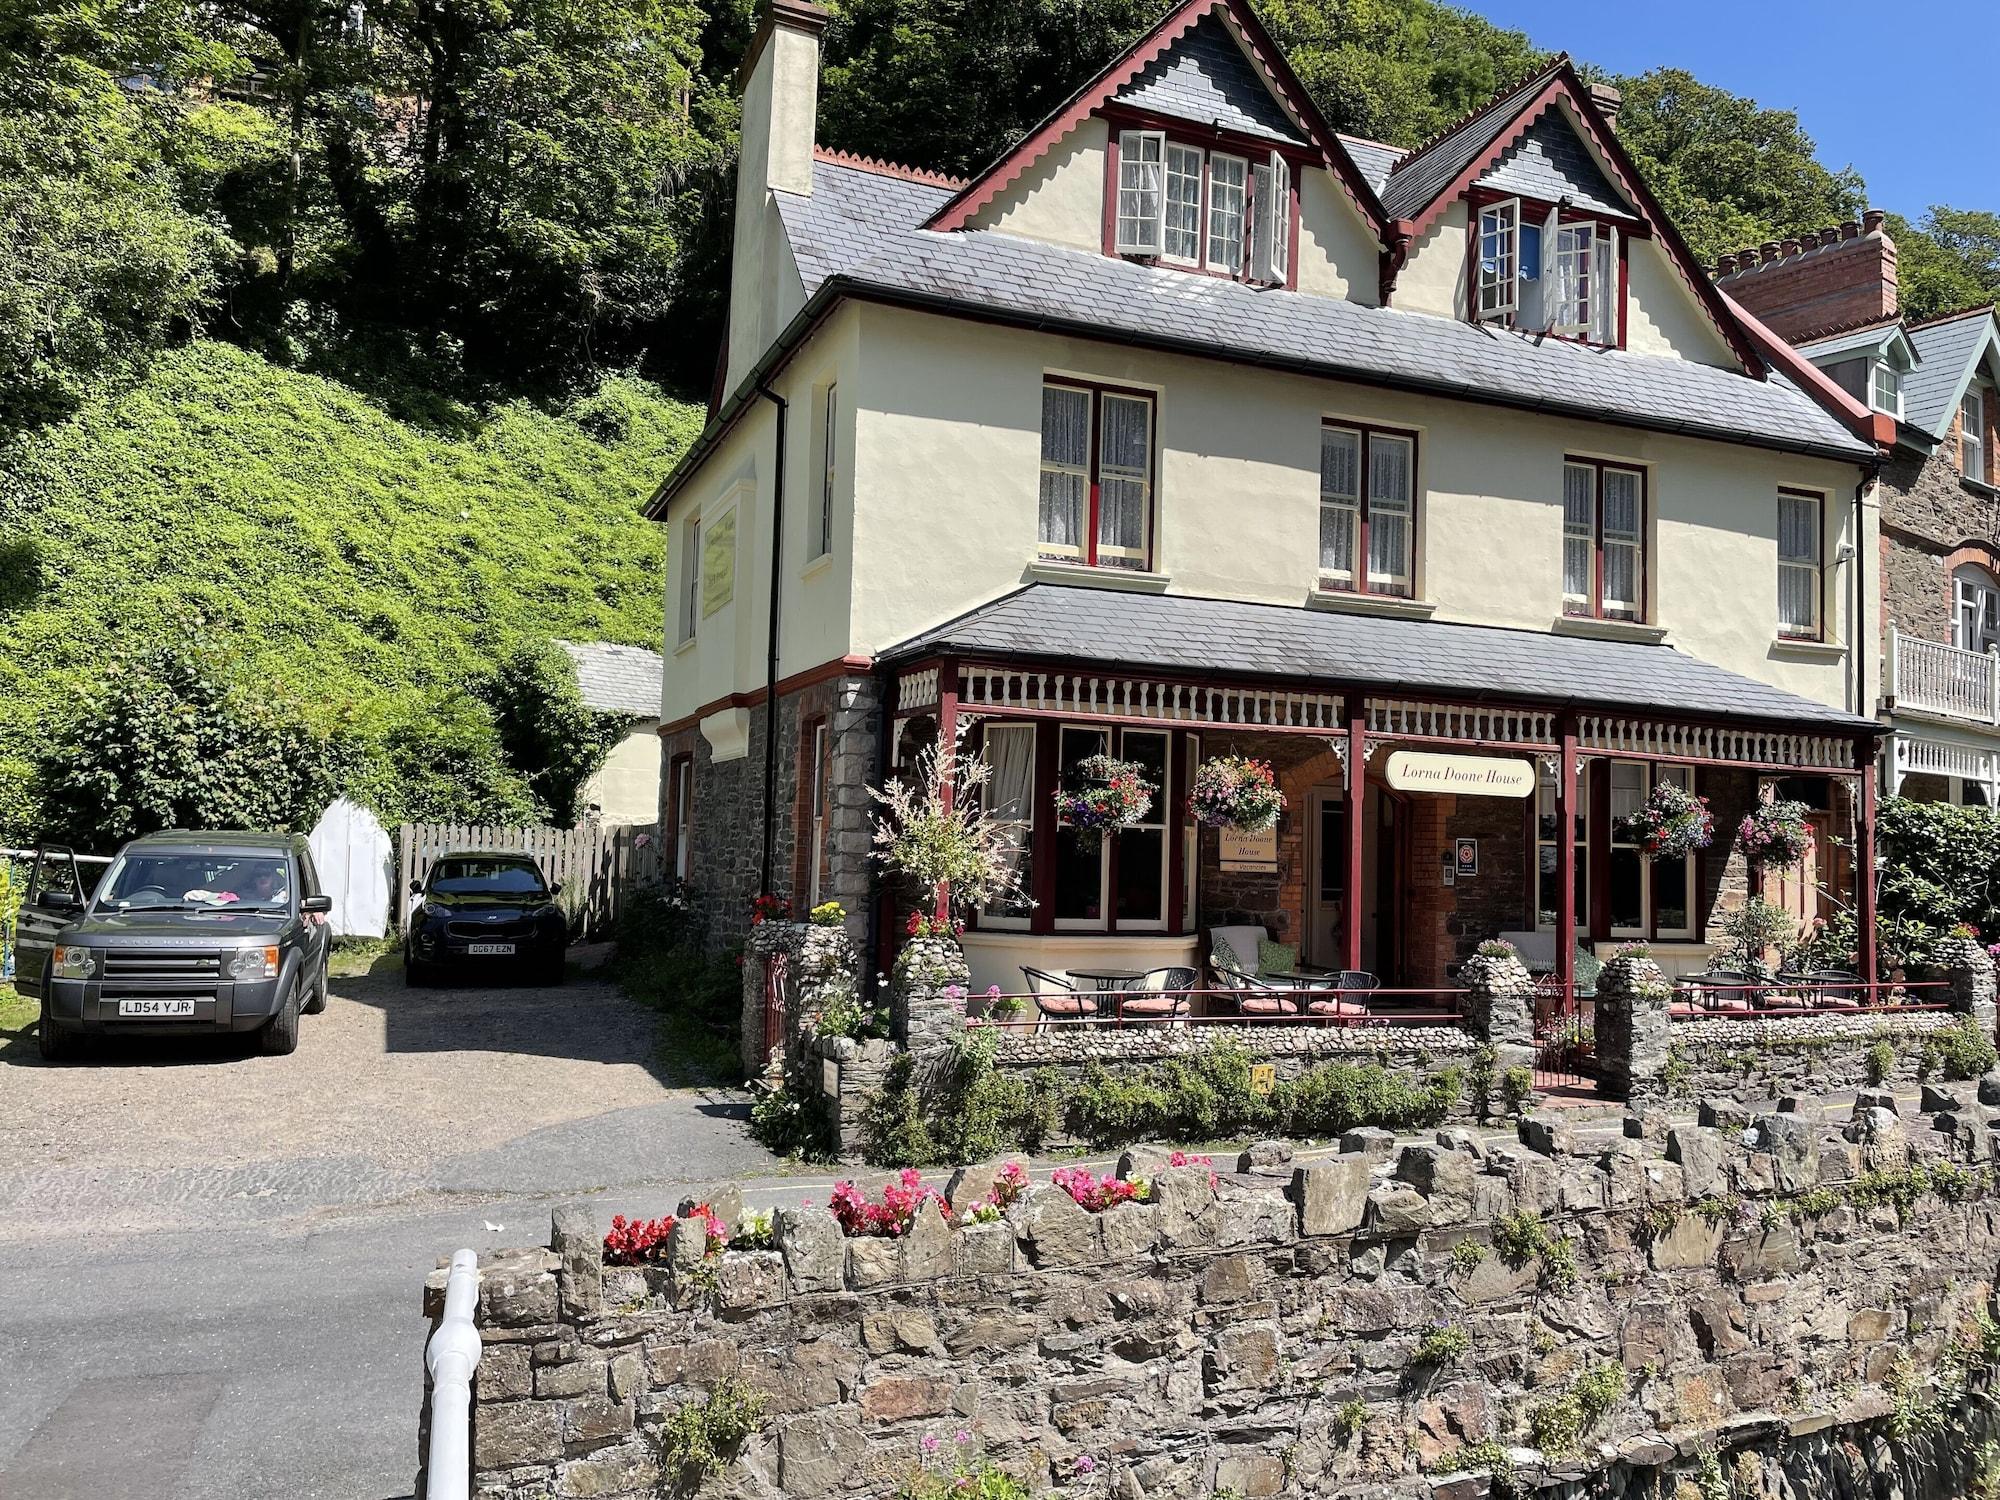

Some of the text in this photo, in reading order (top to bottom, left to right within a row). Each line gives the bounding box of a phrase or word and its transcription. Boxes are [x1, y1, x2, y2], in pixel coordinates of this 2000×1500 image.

[1402, 763, 1523, 785] Lorna Doone House
[1225, 833, 1248, 843] Lorna
[1238, 847, 1261, 857] House
[496, 945, 512, 953] EZN
[125, 1002, 190, 1013] LD54 YJR
